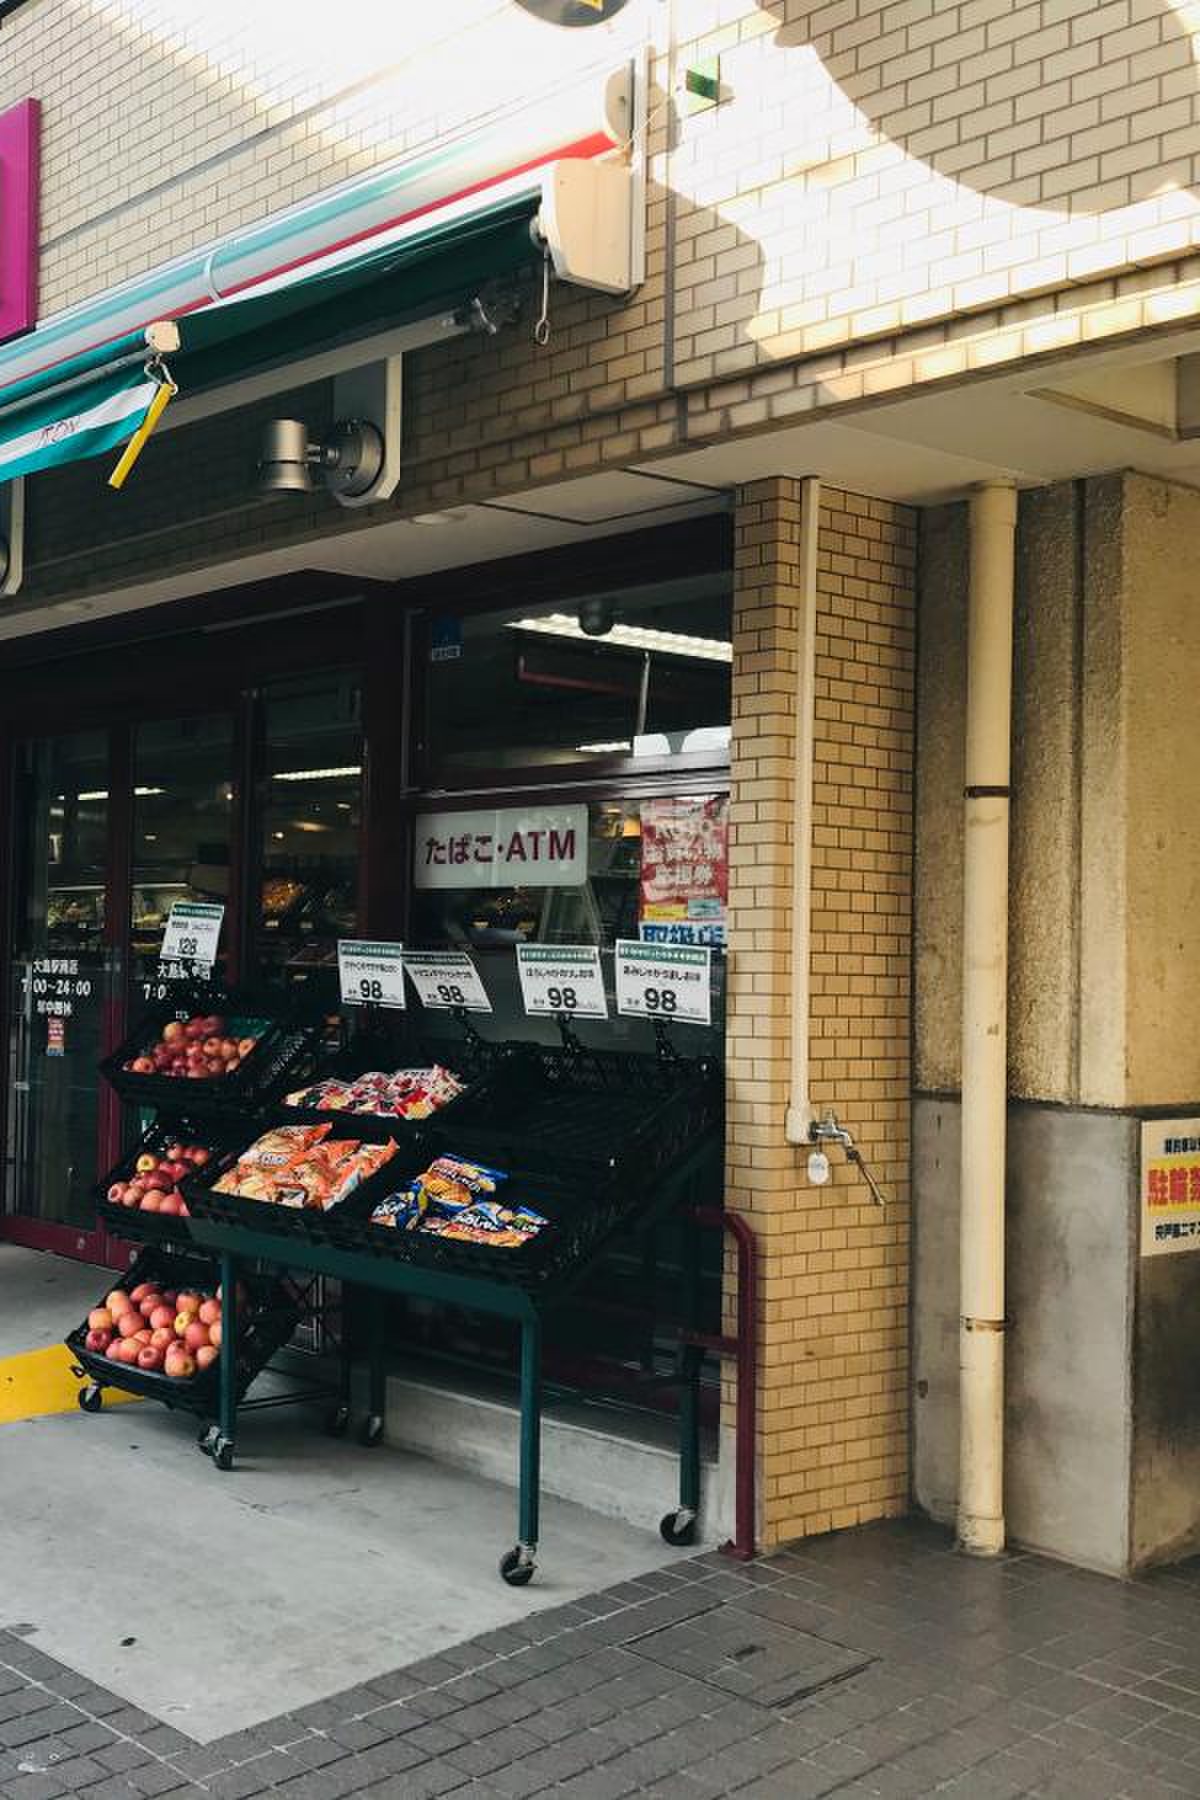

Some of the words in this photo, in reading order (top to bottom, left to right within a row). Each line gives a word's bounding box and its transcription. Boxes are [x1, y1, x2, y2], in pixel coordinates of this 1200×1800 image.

[359, 978, 384, 1000] 98
[547, 987, 578, 1009] 98
[644, 987, 678, 1012] 98
